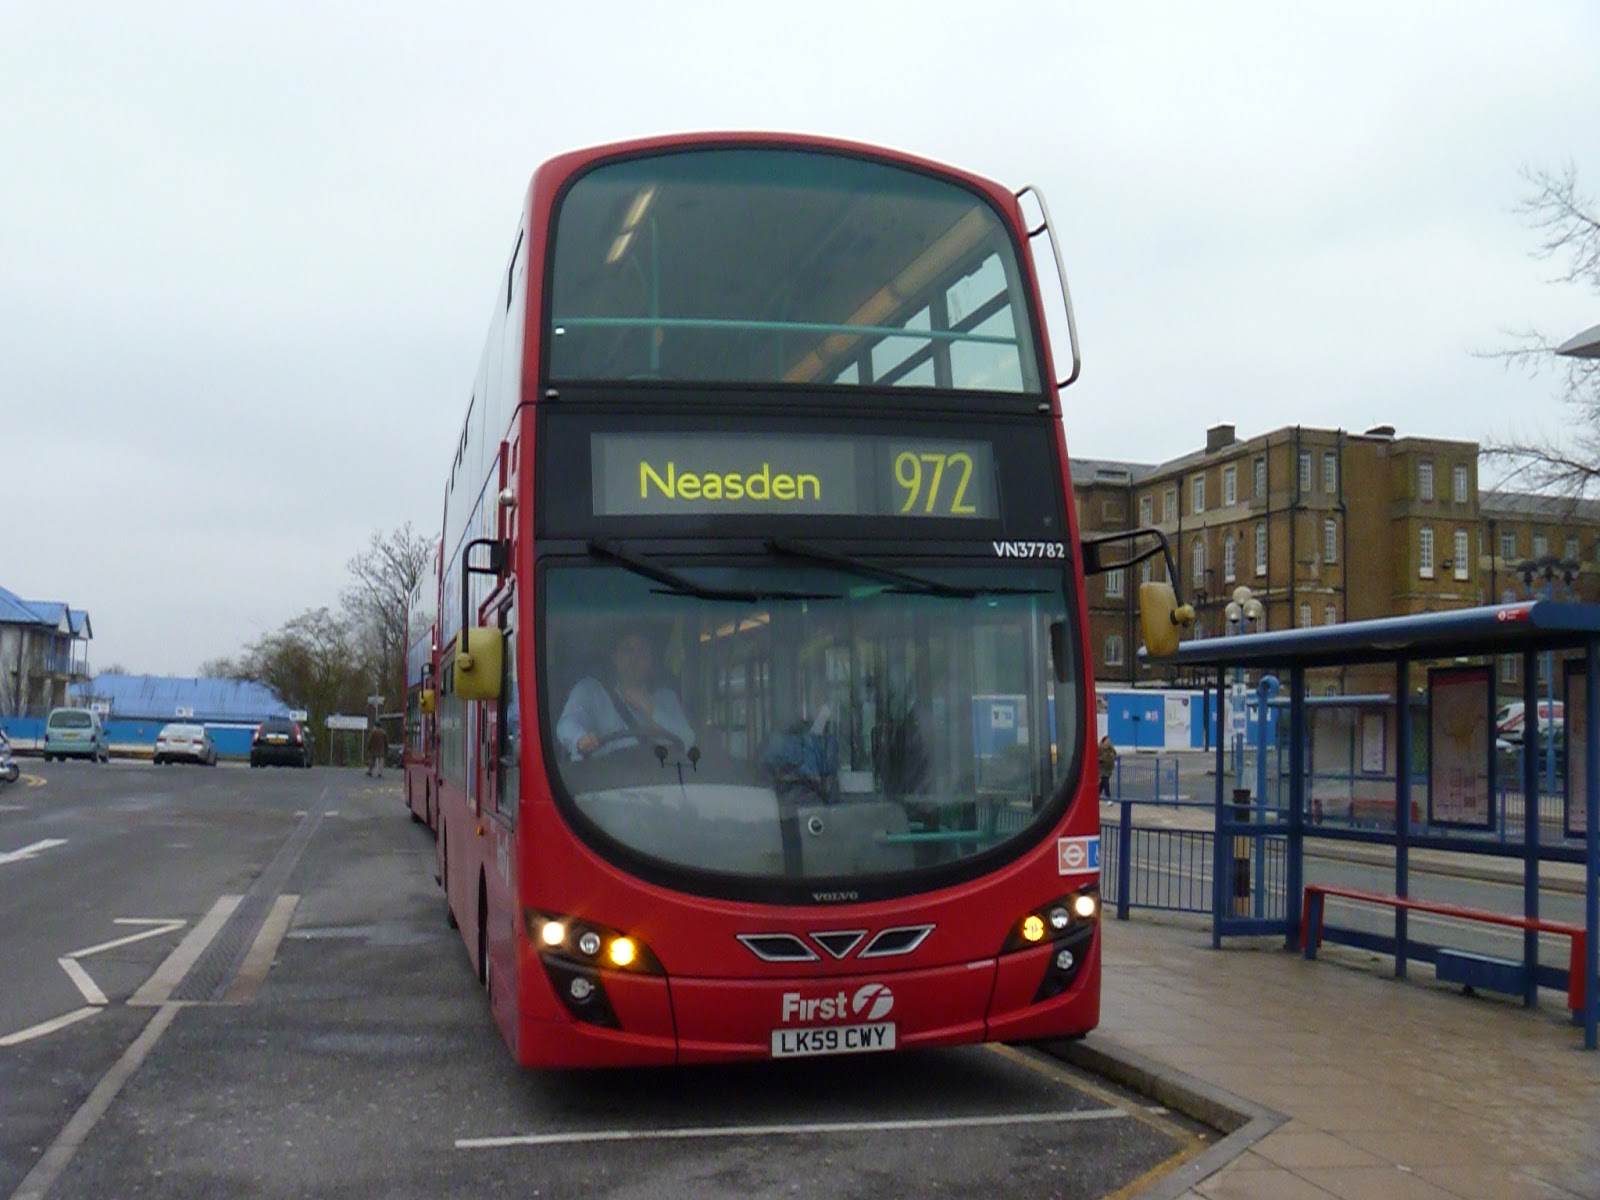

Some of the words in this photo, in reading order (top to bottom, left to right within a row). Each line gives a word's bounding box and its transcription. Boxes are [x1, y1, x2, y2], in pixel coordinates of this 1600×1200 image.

[640, 461, 820, 500] Neasden
[895, 451, 976, 513] 972
[993, 541, 1065, 558] VN37782
[812, 891, 858, 901] VOLVO
[782, 991, 847, 1022] First
[781, 1029, 838, 1053] LK59
[845, 1026, 886, 1048] CWY
